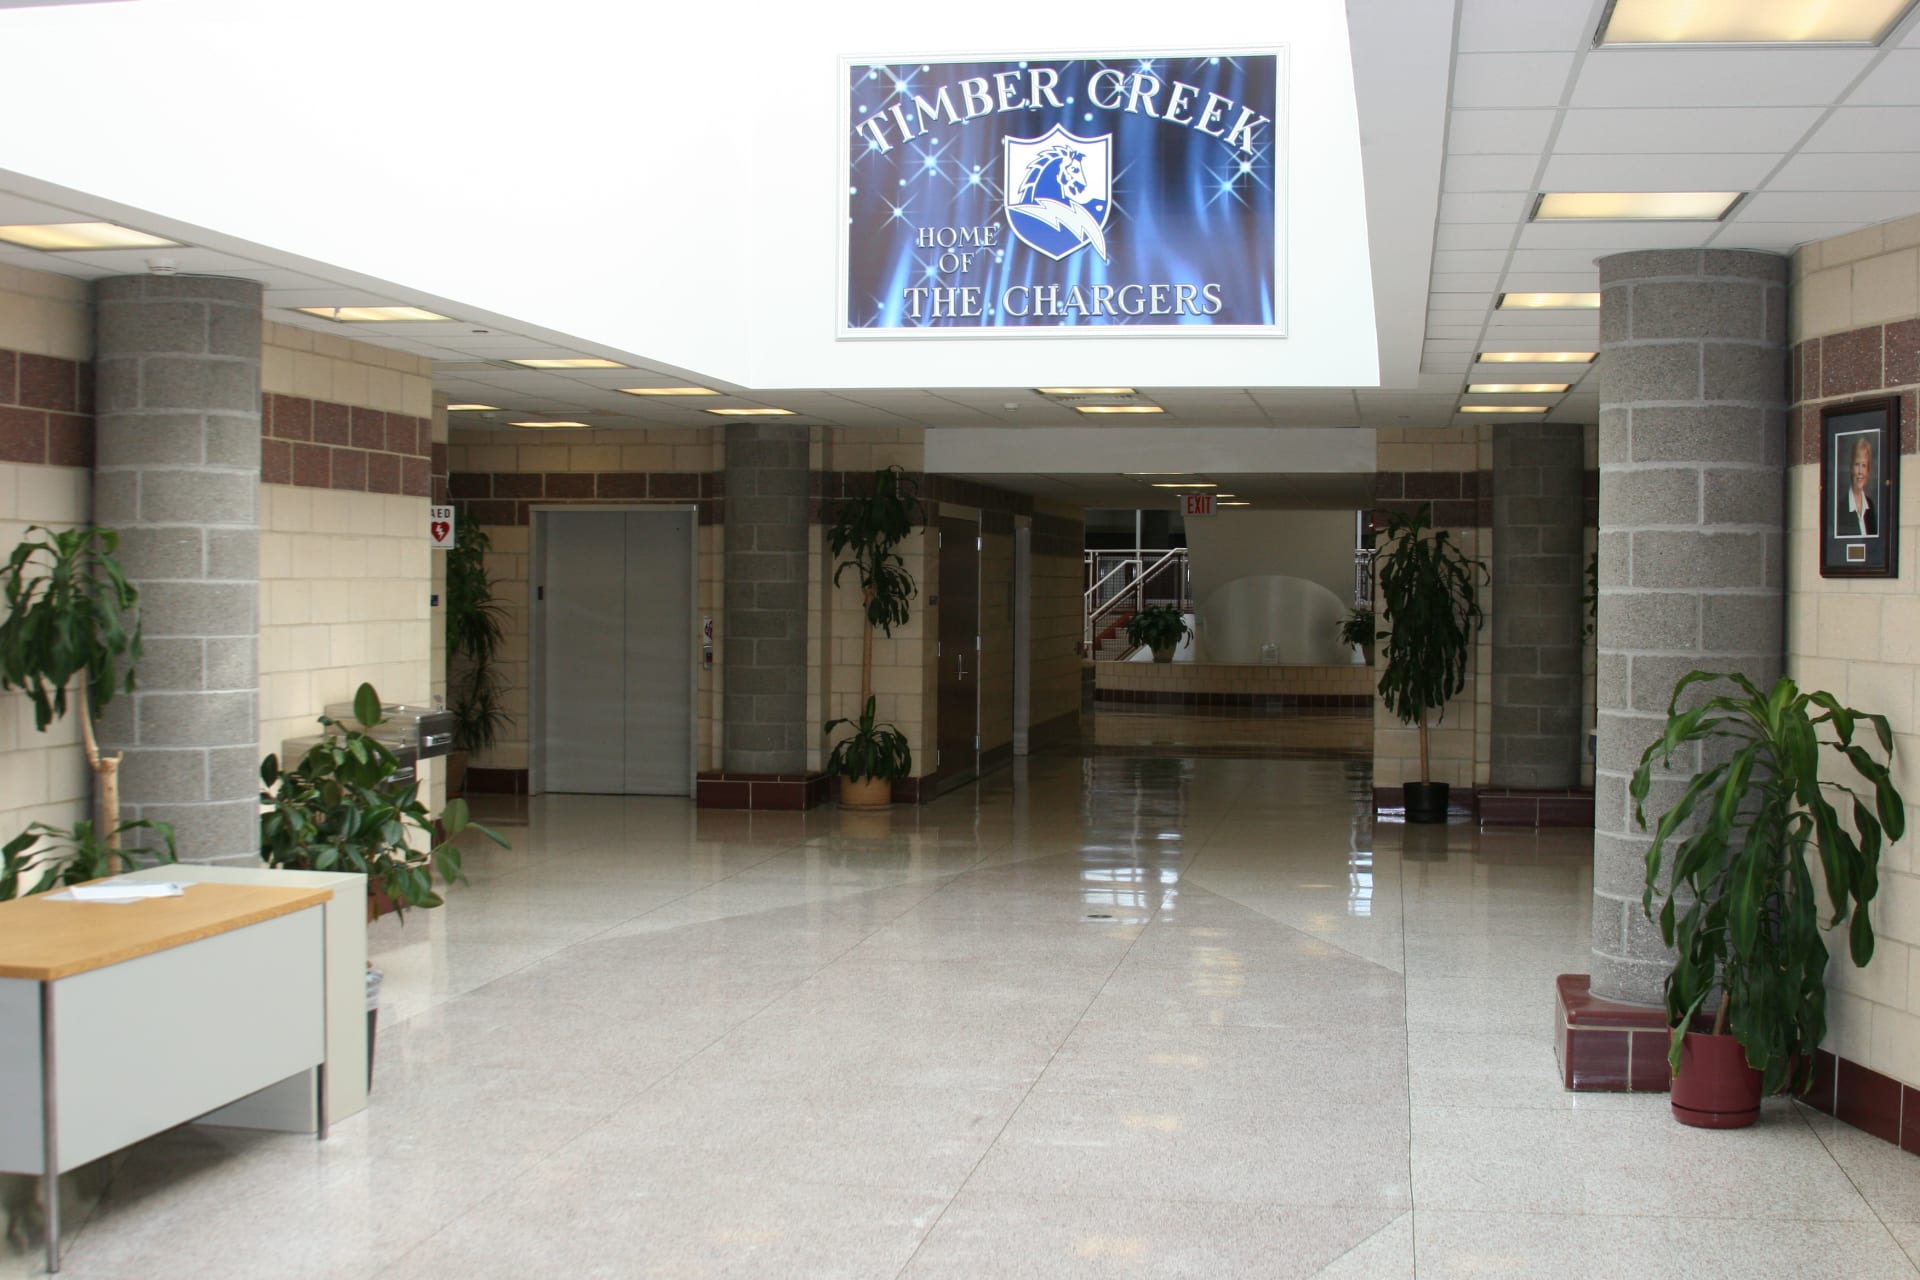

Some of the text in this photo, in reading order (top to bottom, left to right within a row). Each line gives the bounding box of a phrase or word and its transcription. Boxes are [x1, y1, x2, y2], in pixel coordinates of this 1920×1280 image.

[856, 68, 1270, 155] TIMBER CREEK
[917, 226, 998, 247] HOME
[938, 252, 975, 274] OF
[903, 283, 1223, 318] THE CHARGERS
[1187, 495, 1212, 514] EXIT
